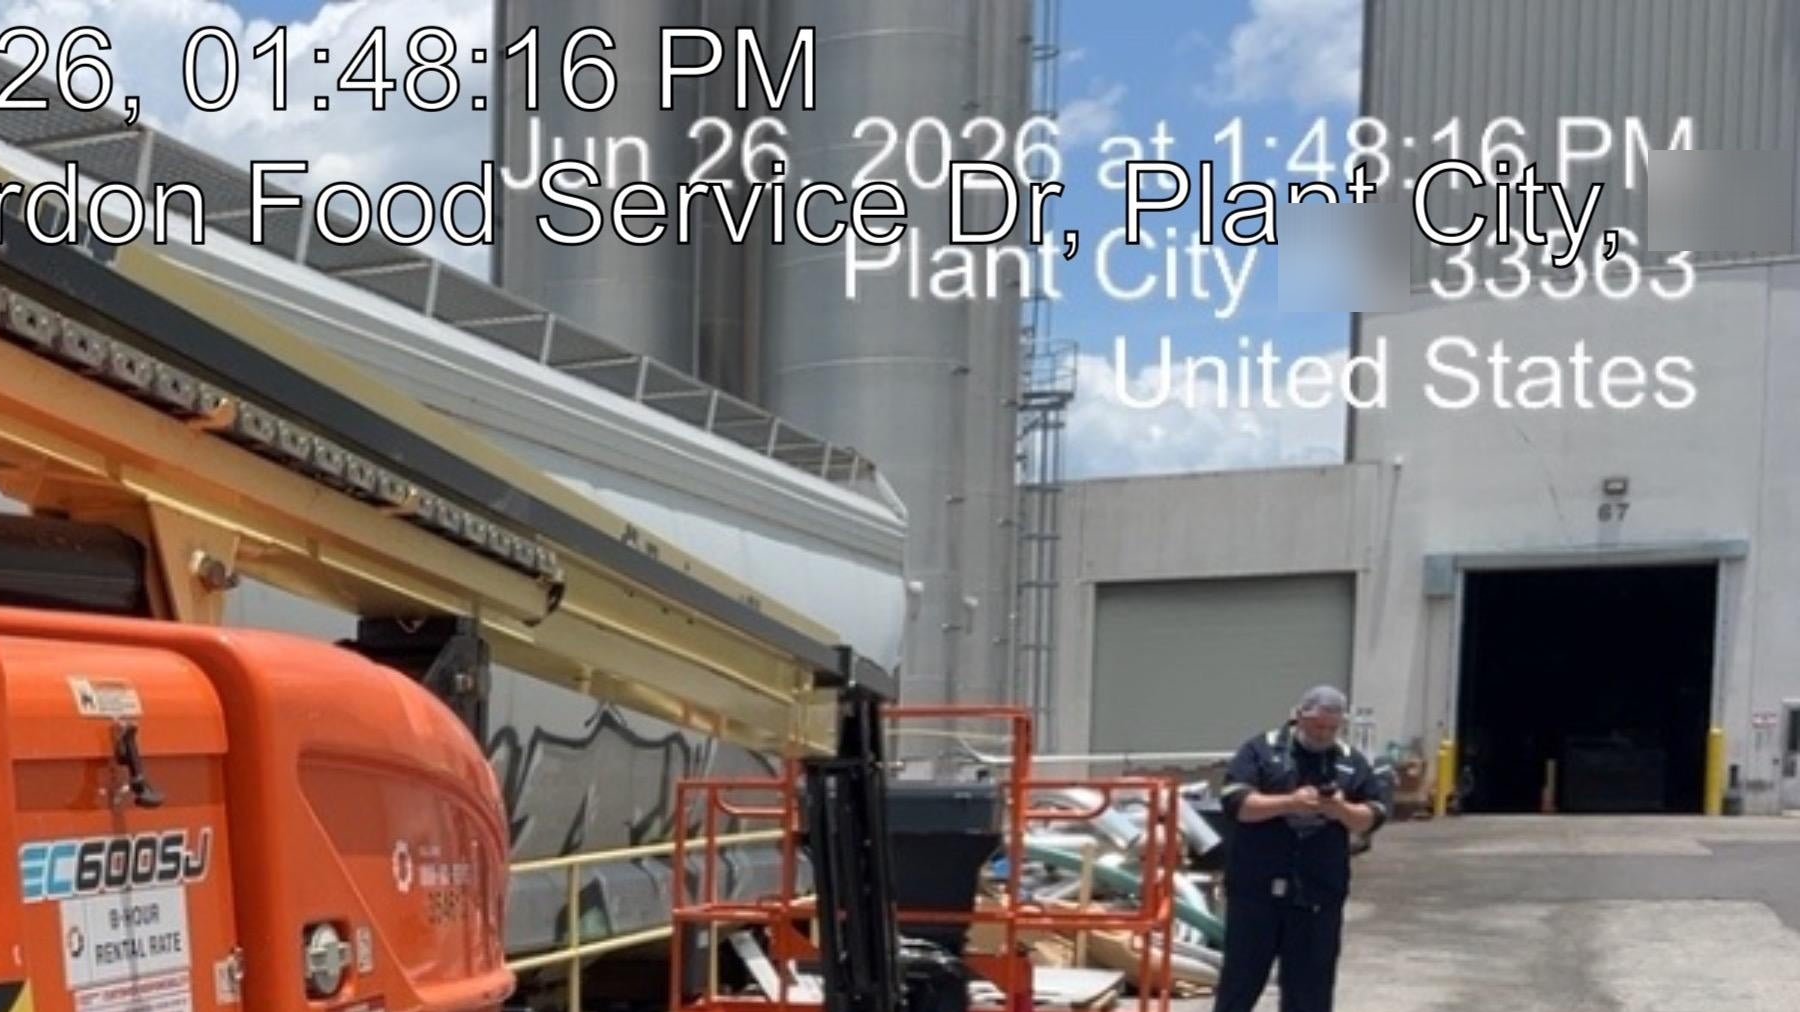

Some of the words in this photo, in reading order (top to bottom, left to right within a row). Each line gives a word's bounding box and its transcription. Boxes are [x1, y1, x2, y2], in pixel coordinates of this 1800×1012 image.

[19, 827, 212, 903] EC600SJ
[95, 938, 147, 966] RENTAL
[149, 932, 182, 954] RATE
